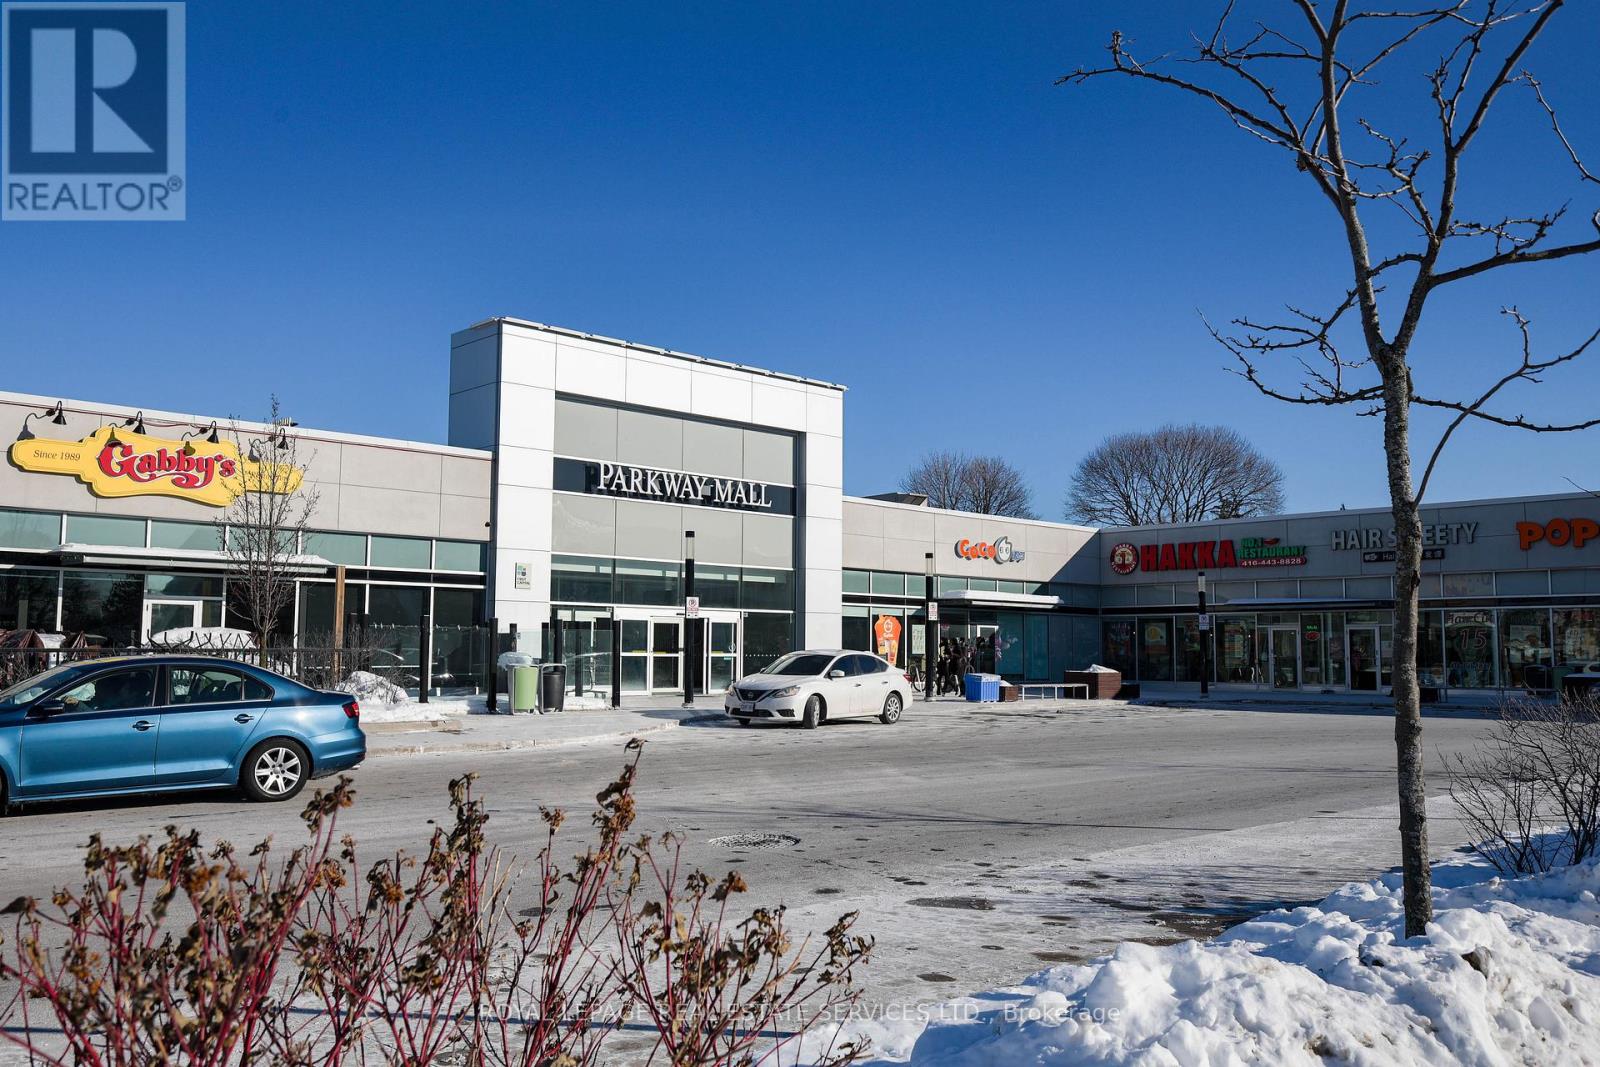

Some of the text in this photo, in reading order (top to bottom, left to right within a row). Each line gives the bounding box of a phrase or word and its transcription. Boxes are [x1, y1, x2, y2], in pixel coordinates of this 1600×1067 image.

[33, 449, 81, 461] Since 1989
[97, 442, 237, 489] Gabby's
[597, 462, 773, 508] PARKWAY MALL
[1332, 521, 1478, 551] HAIR SEETY
[1140, 540, 1237, 571] HAKKA
[1239, 546, 1306, 558] RESTAURANT
[1241, 558, 1302, 567] 416-443-8828
[1459, 628, 1488, 650] 15
